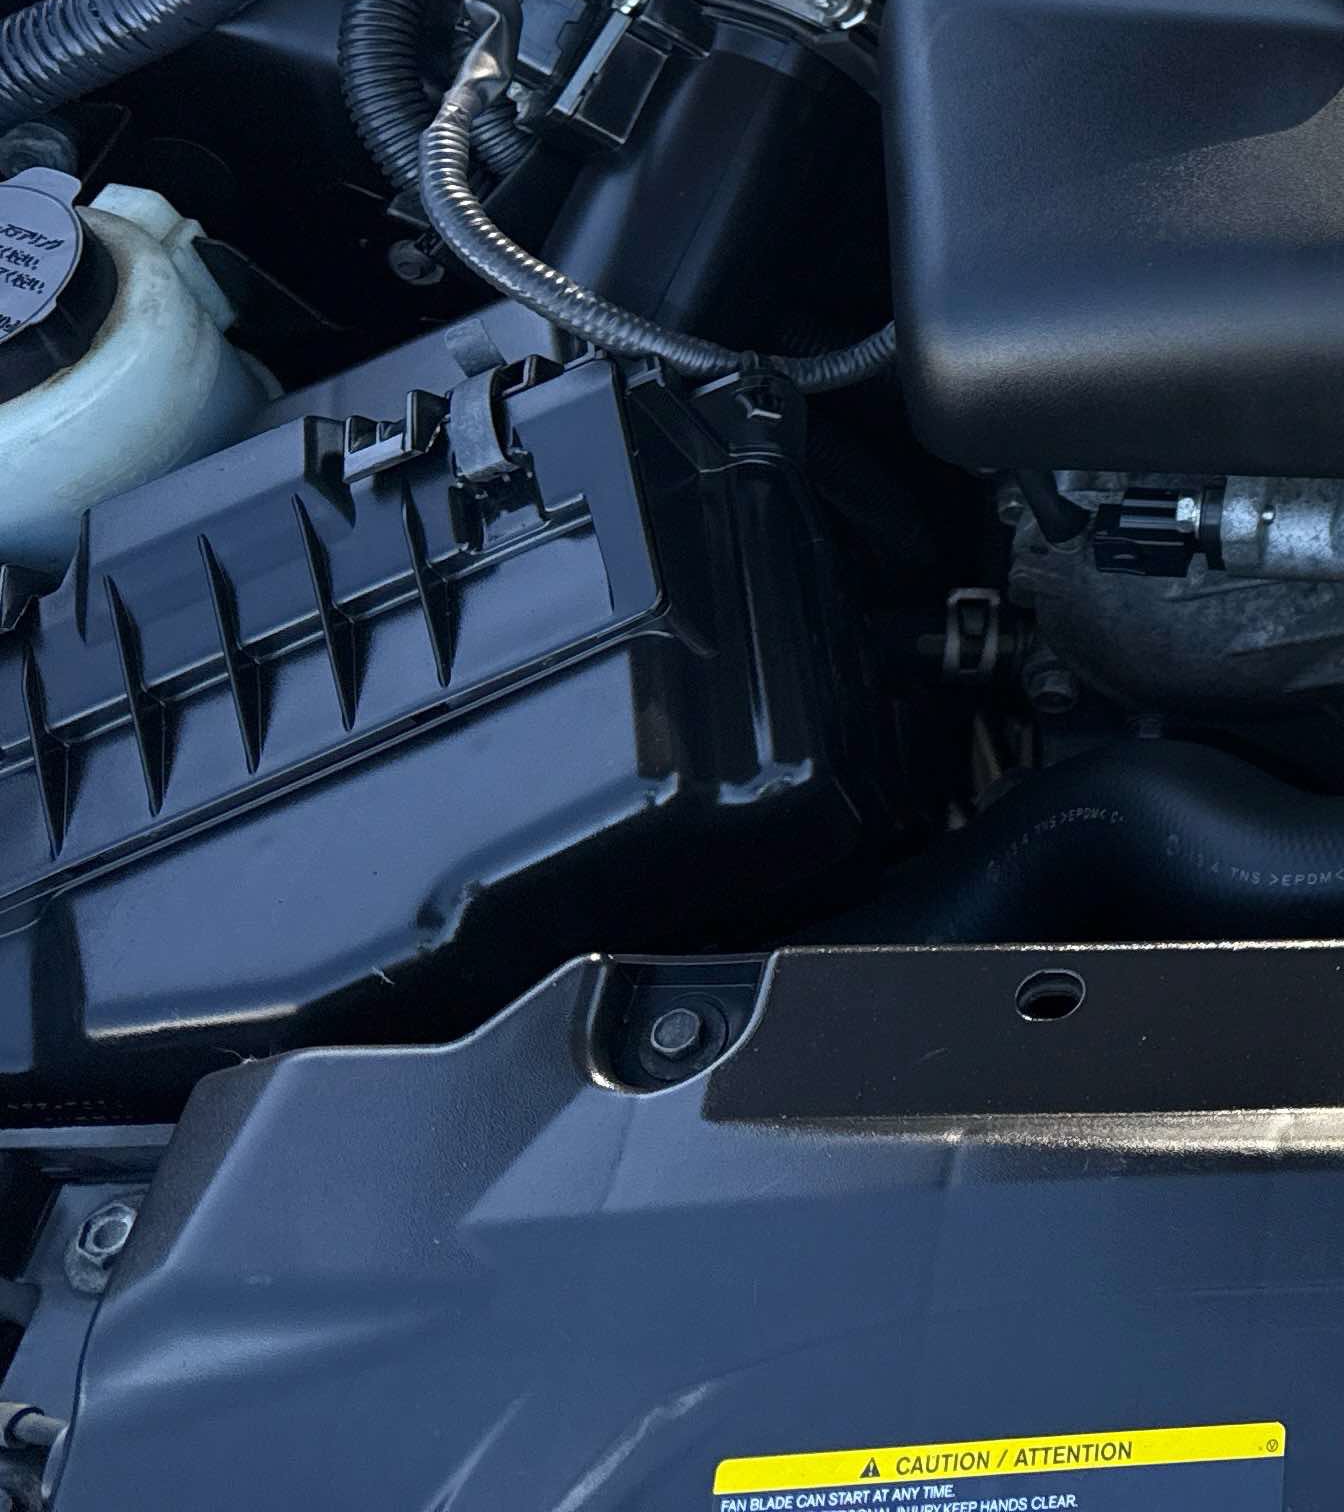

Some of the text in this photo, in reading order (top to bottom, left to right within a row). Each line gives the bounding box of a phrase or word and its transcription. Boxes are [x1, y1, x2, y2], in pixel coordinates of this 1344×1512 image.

[895, 1450, 991, 1476] CAUTION
[1013, 1441, 1133, 1466] ATTENTION
[720, 1484, 956, 1512] FAN BLADE CAN START AT ANY TIME.
[980, 1497, 1028, 1512] HANDS
[1030, 1494, 1078, 1509] CLEAR.
